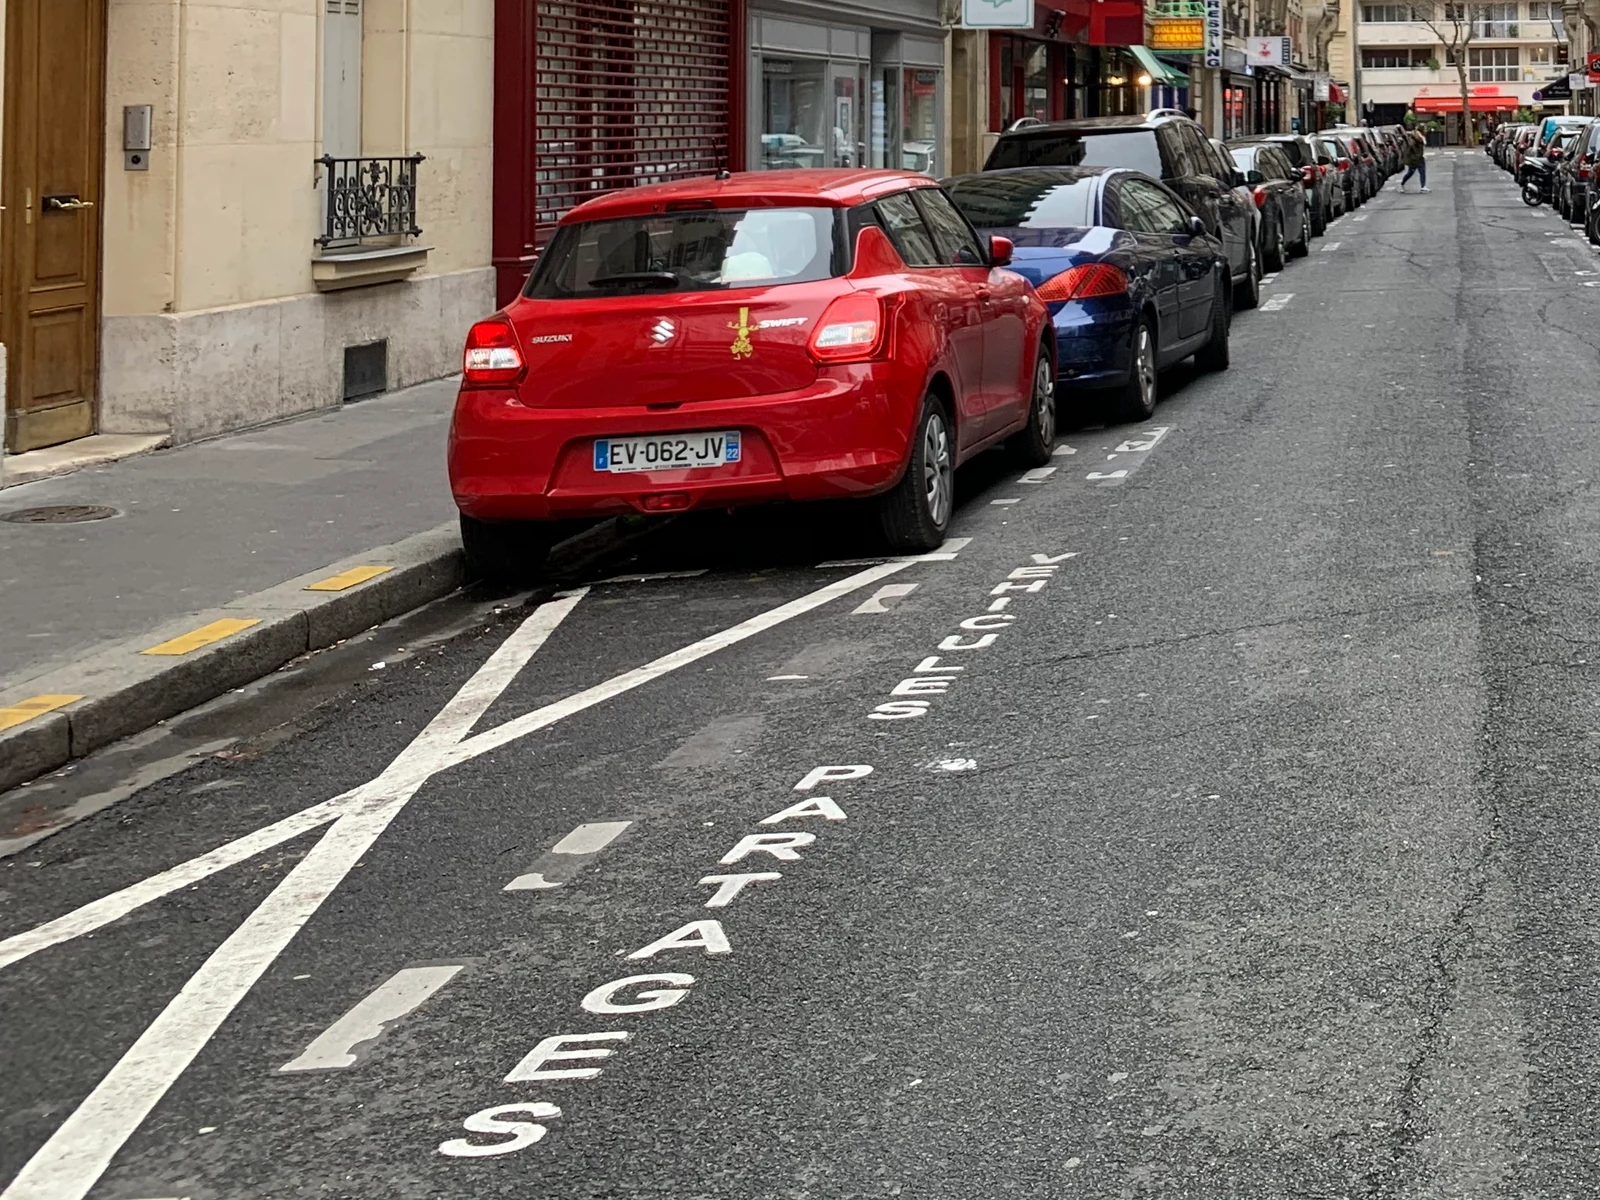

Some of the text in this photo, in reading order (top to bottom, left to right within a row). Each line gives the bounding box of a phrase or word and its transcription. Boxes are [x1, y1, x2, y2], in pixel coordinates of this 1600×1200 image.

[759, 317, 808, 329] SWIFT
[532, 333, 573, 345] SUZUKI
[610, 437, 723, 465] EV-062-JV
[726, 447, 739, 460] 22
[867, 552, 1078, 720] VEHICULES
[437, 763, 875, 1158] PARTAGES
